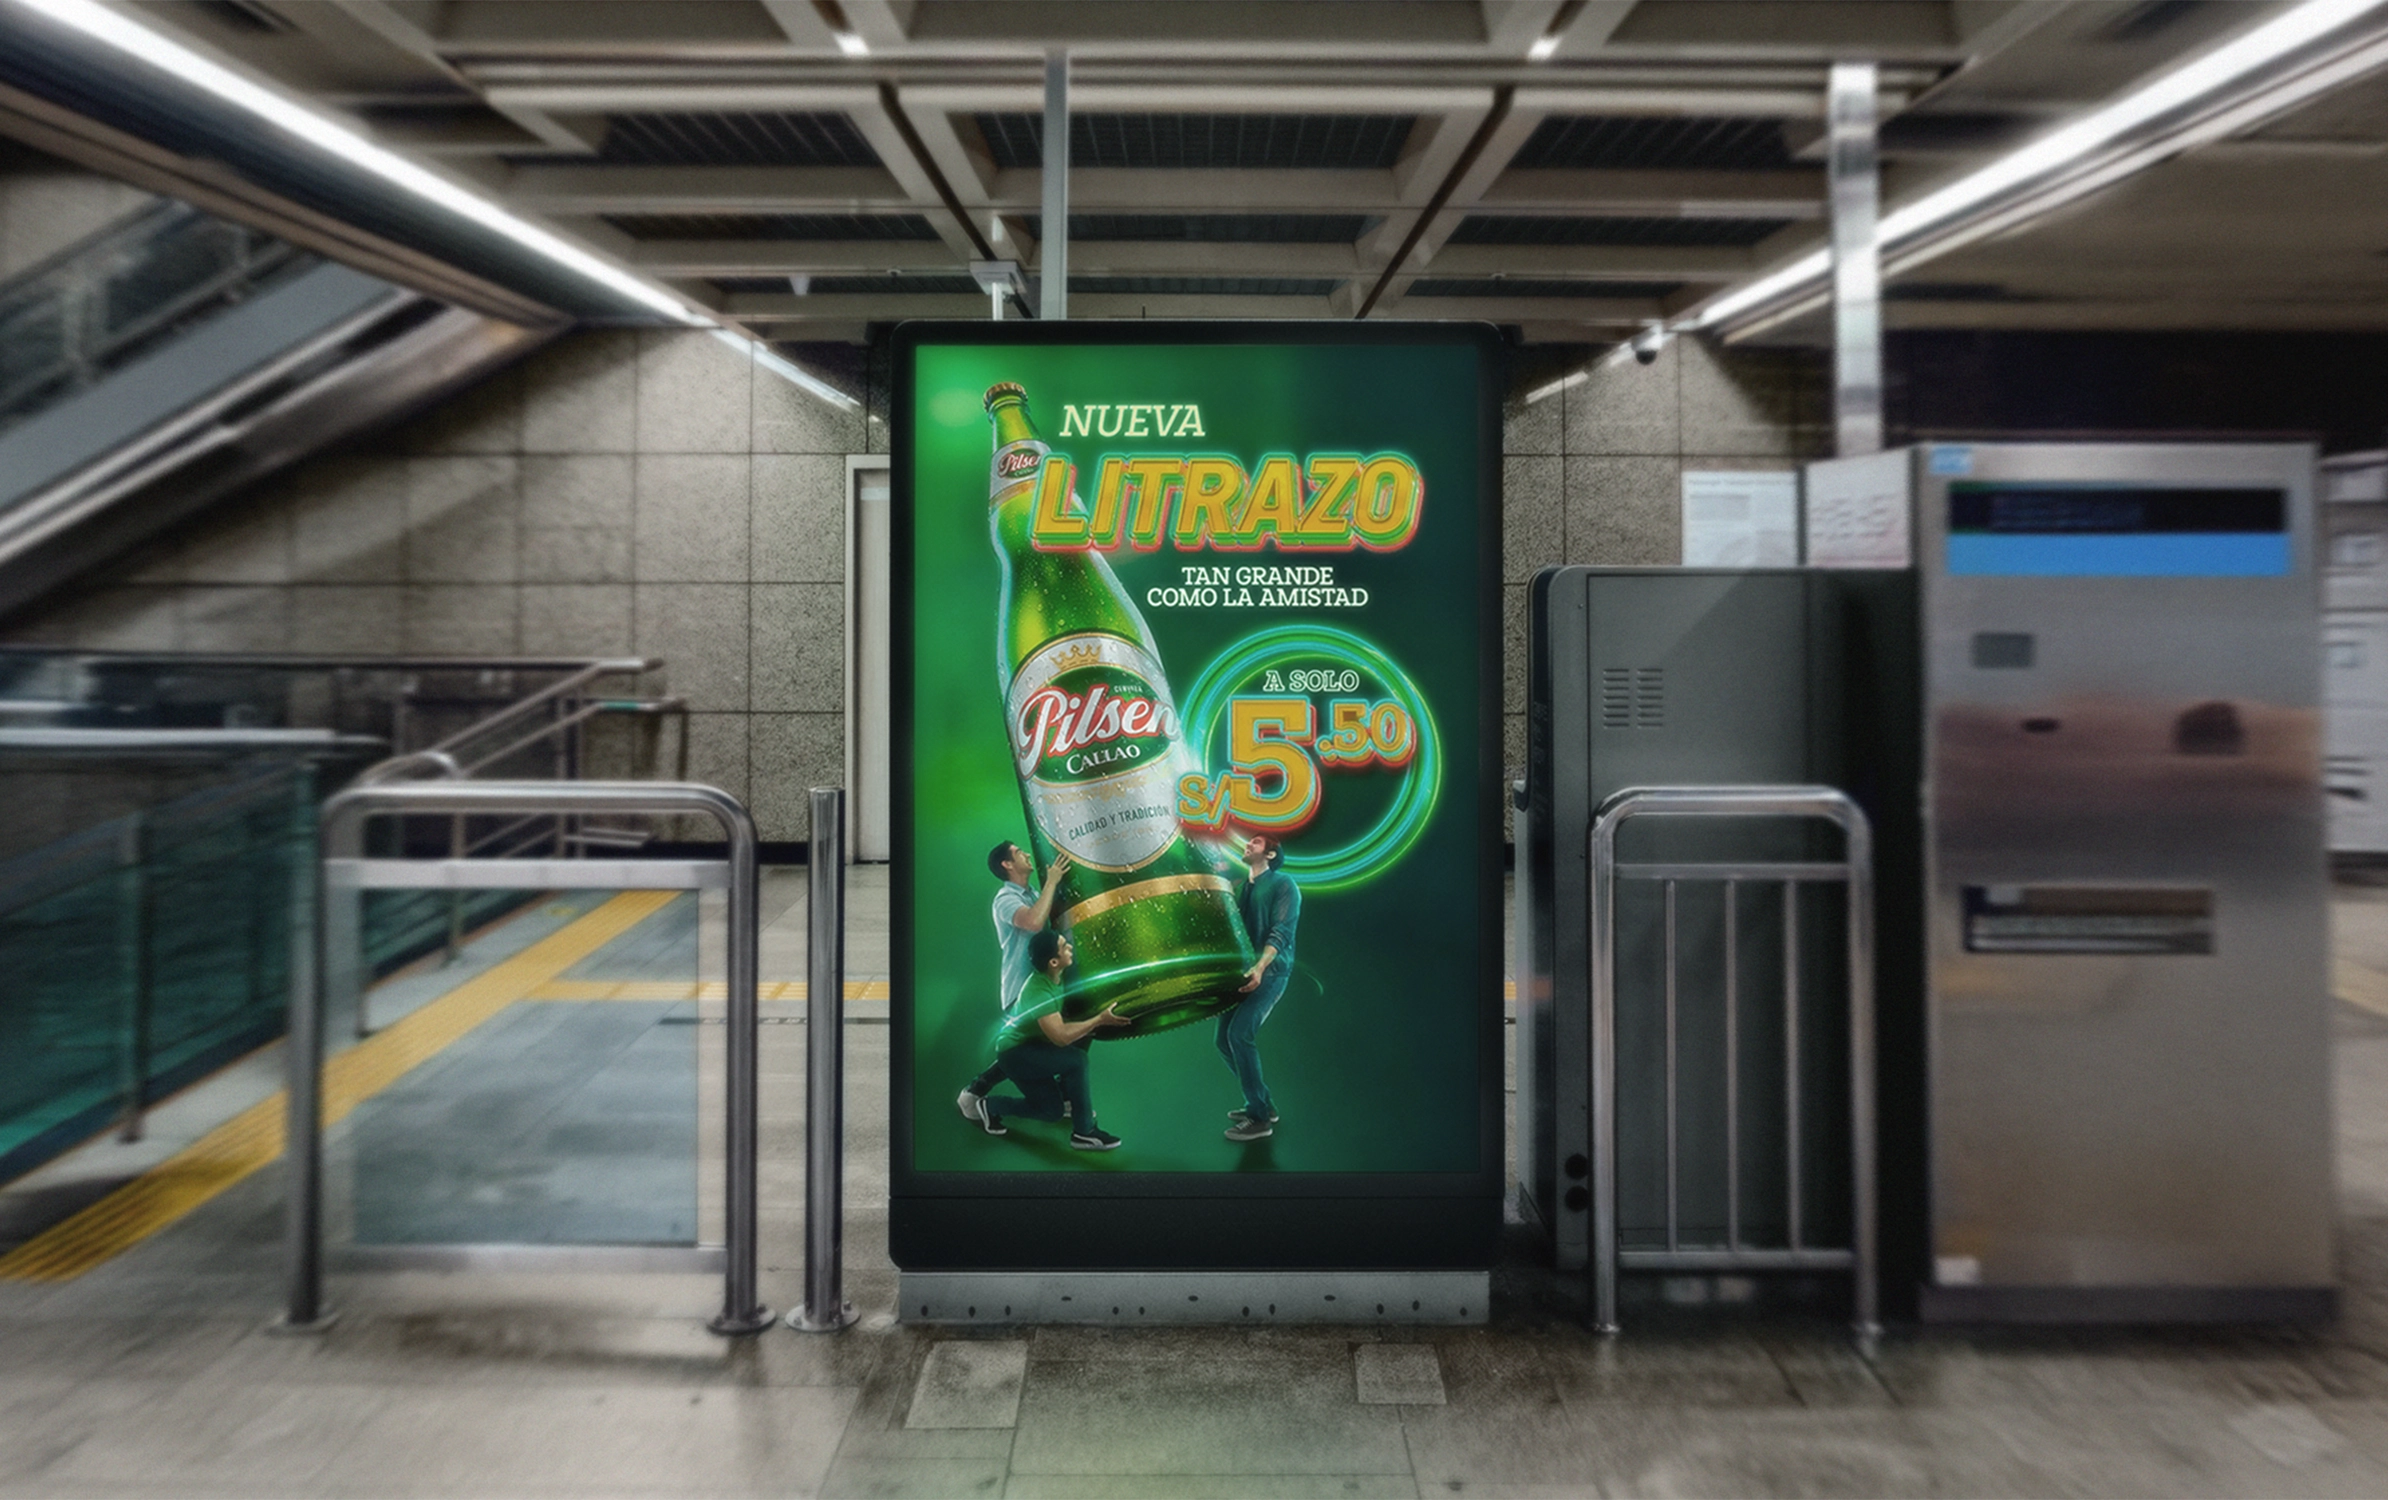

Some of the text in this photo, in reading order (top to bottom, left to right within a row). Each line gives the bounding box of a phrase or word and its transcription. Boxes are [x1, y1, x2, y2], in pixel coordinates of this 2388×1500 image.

[1059, 404, 1206, 437] NUEVA
[1030, 453, 1424, 551] LITRAZO
[1181, 566, 1334, 586] TAN GRANDE
[1147, 588, 1369, 607] COMO LA AMISTAD
[1263, 669, 1360, 692] A SOLO
[1016, 683, 1181, 780] Pilsen
[1065, 744, 1141, 774] CALLAO
[1068, 816, 1108, 841] CALIDAD
[1108, 813, 1117, 826] Y
